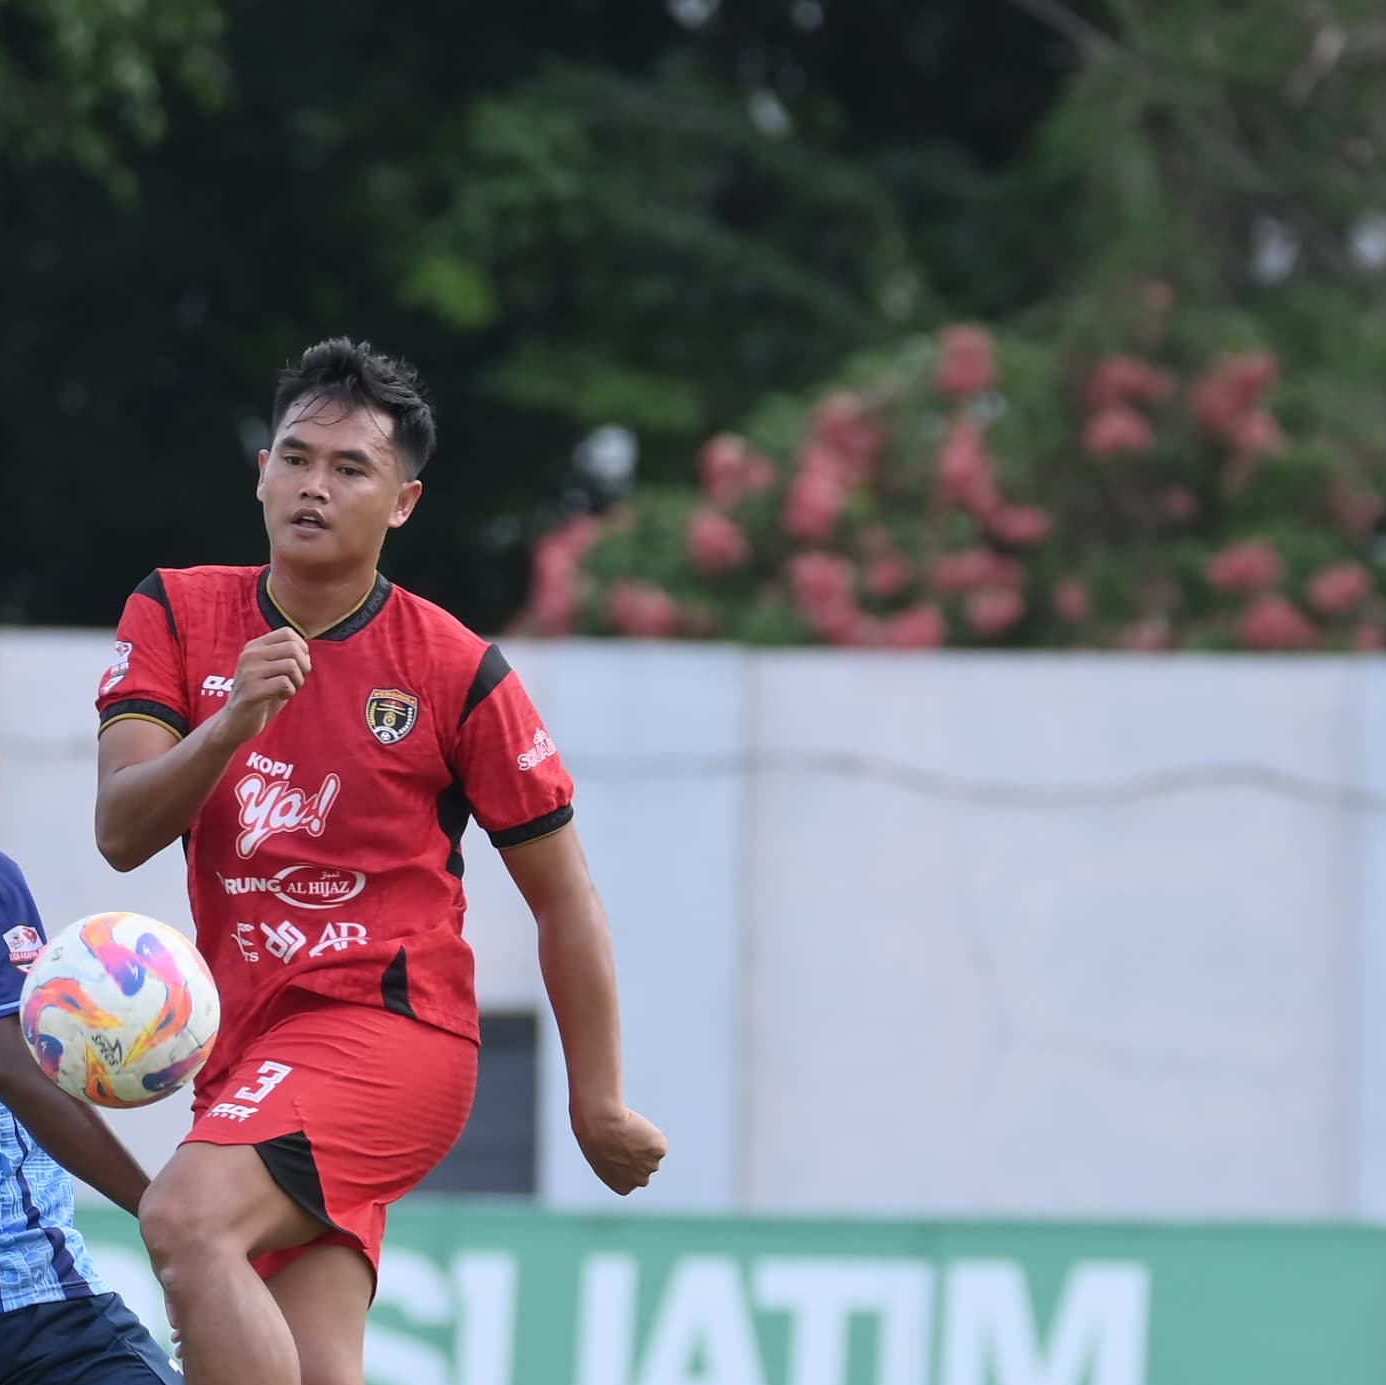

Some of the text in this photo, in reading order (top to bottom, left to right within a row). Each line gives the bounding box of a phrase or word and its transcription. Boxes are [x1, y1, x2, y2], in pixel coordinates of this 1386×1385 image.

[245, 752, 294, 780] KOPI
[219, 874, 350, 897] RUNG AL HIJAZ
[234, 1060, 293, 1103] 3
